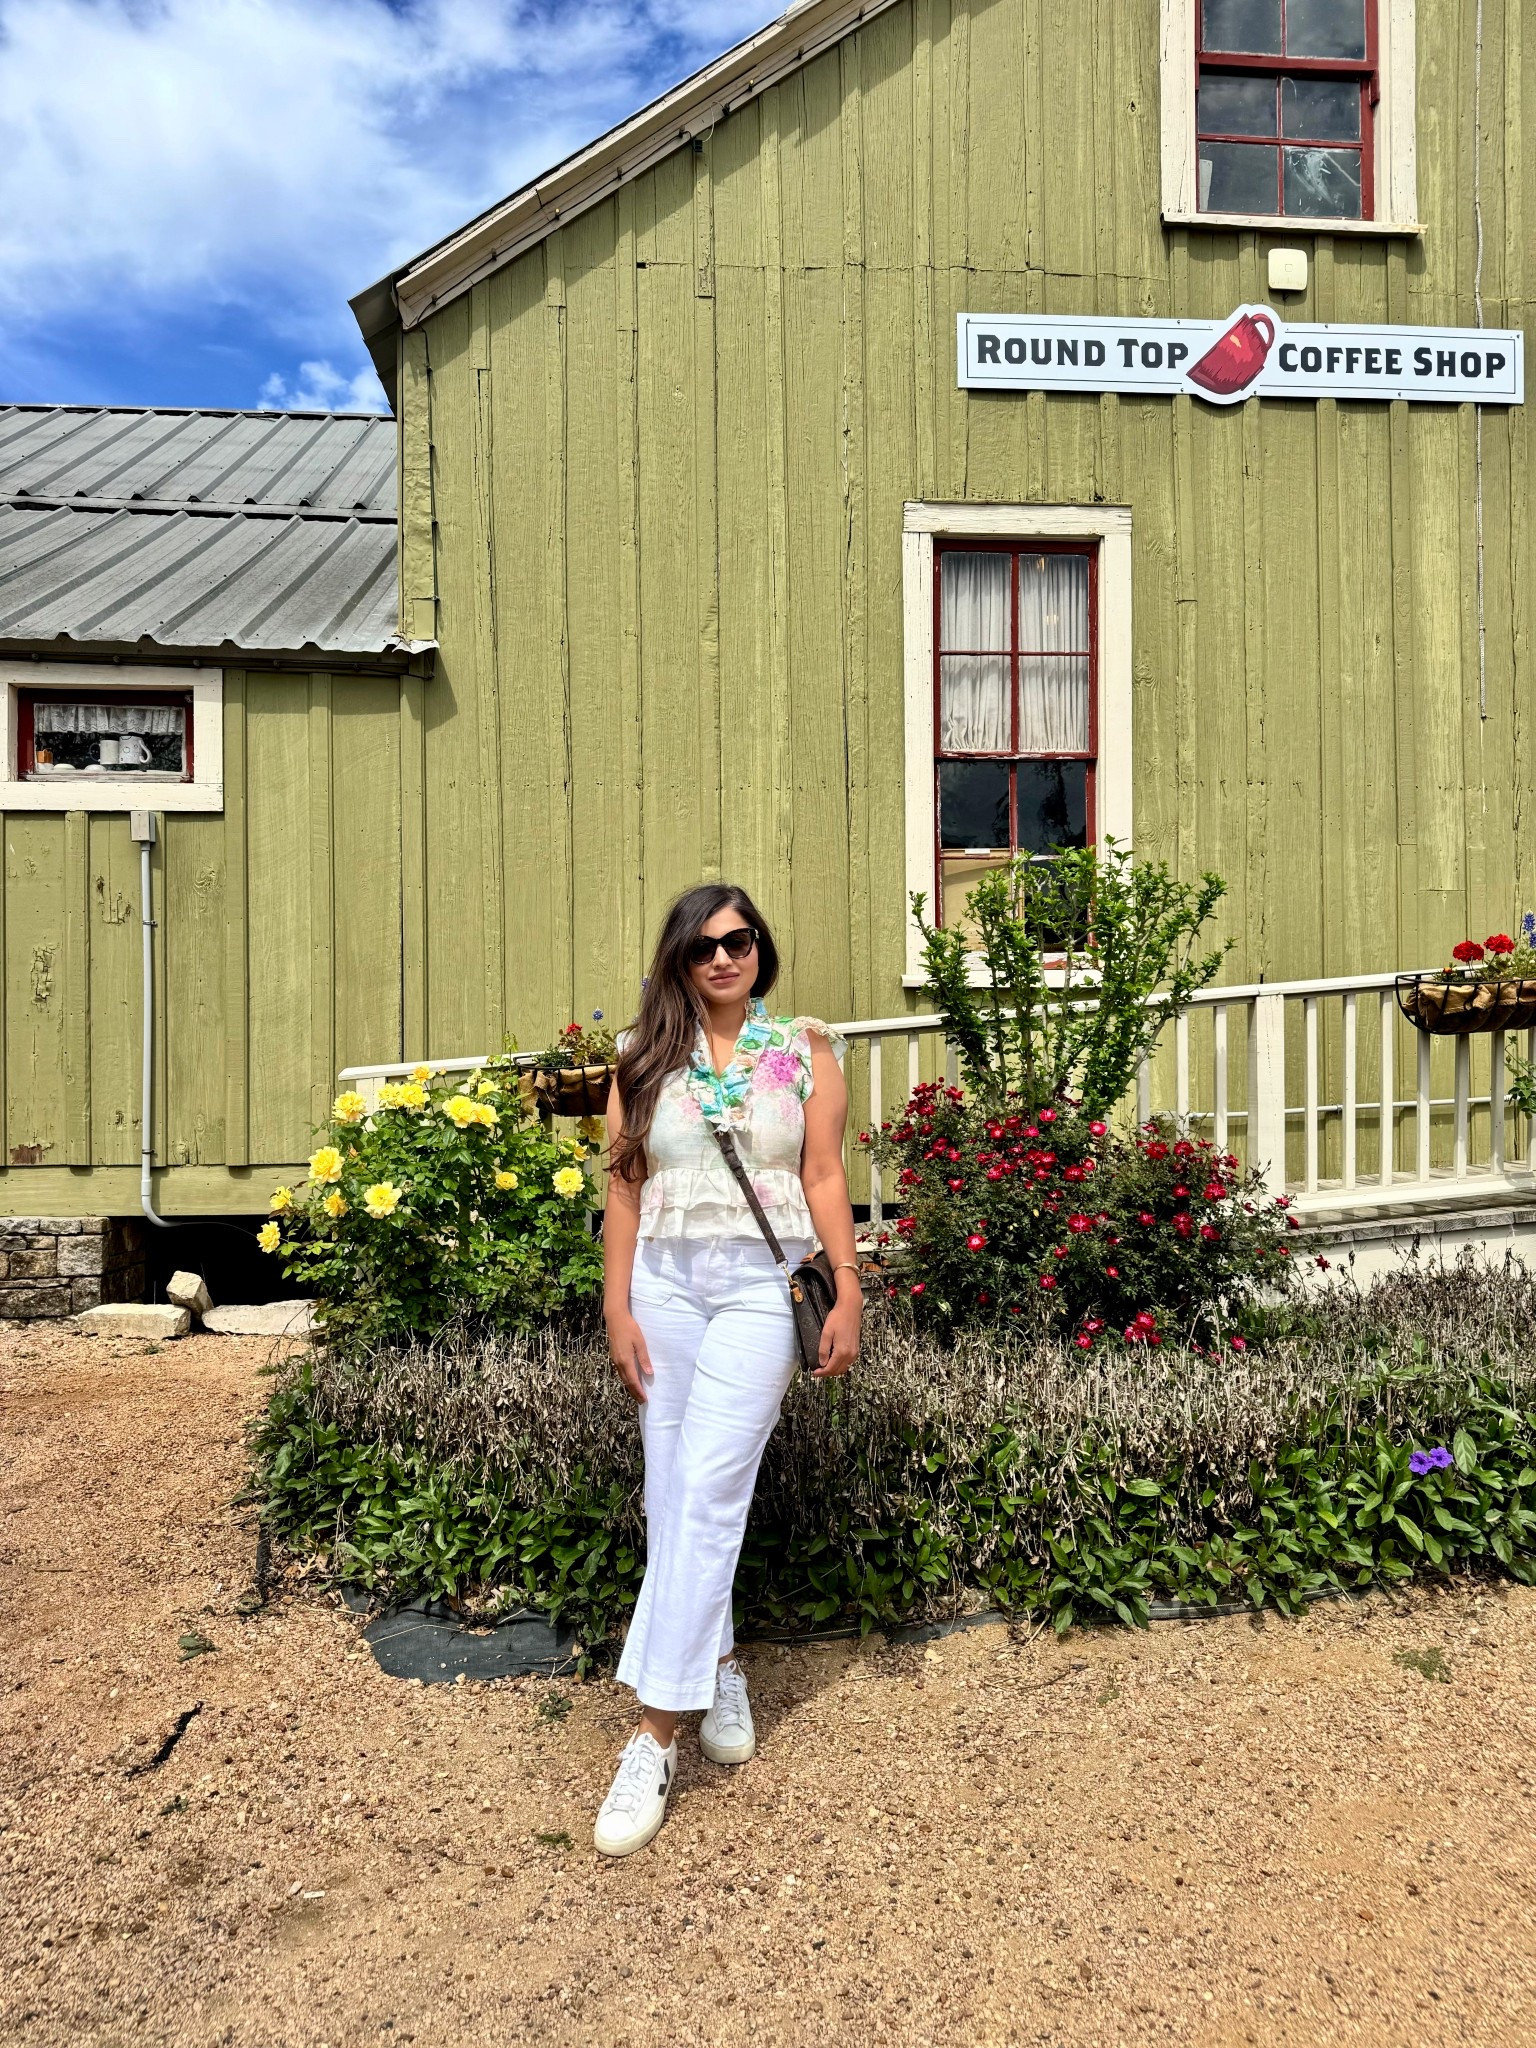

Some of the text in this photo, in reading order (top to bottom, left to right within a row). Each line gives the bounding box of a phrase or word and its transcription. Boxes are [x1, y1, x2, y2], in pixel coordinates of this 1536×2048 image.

[977, 334, 1506, 379] ROUND TOP COFFEE SHOP
